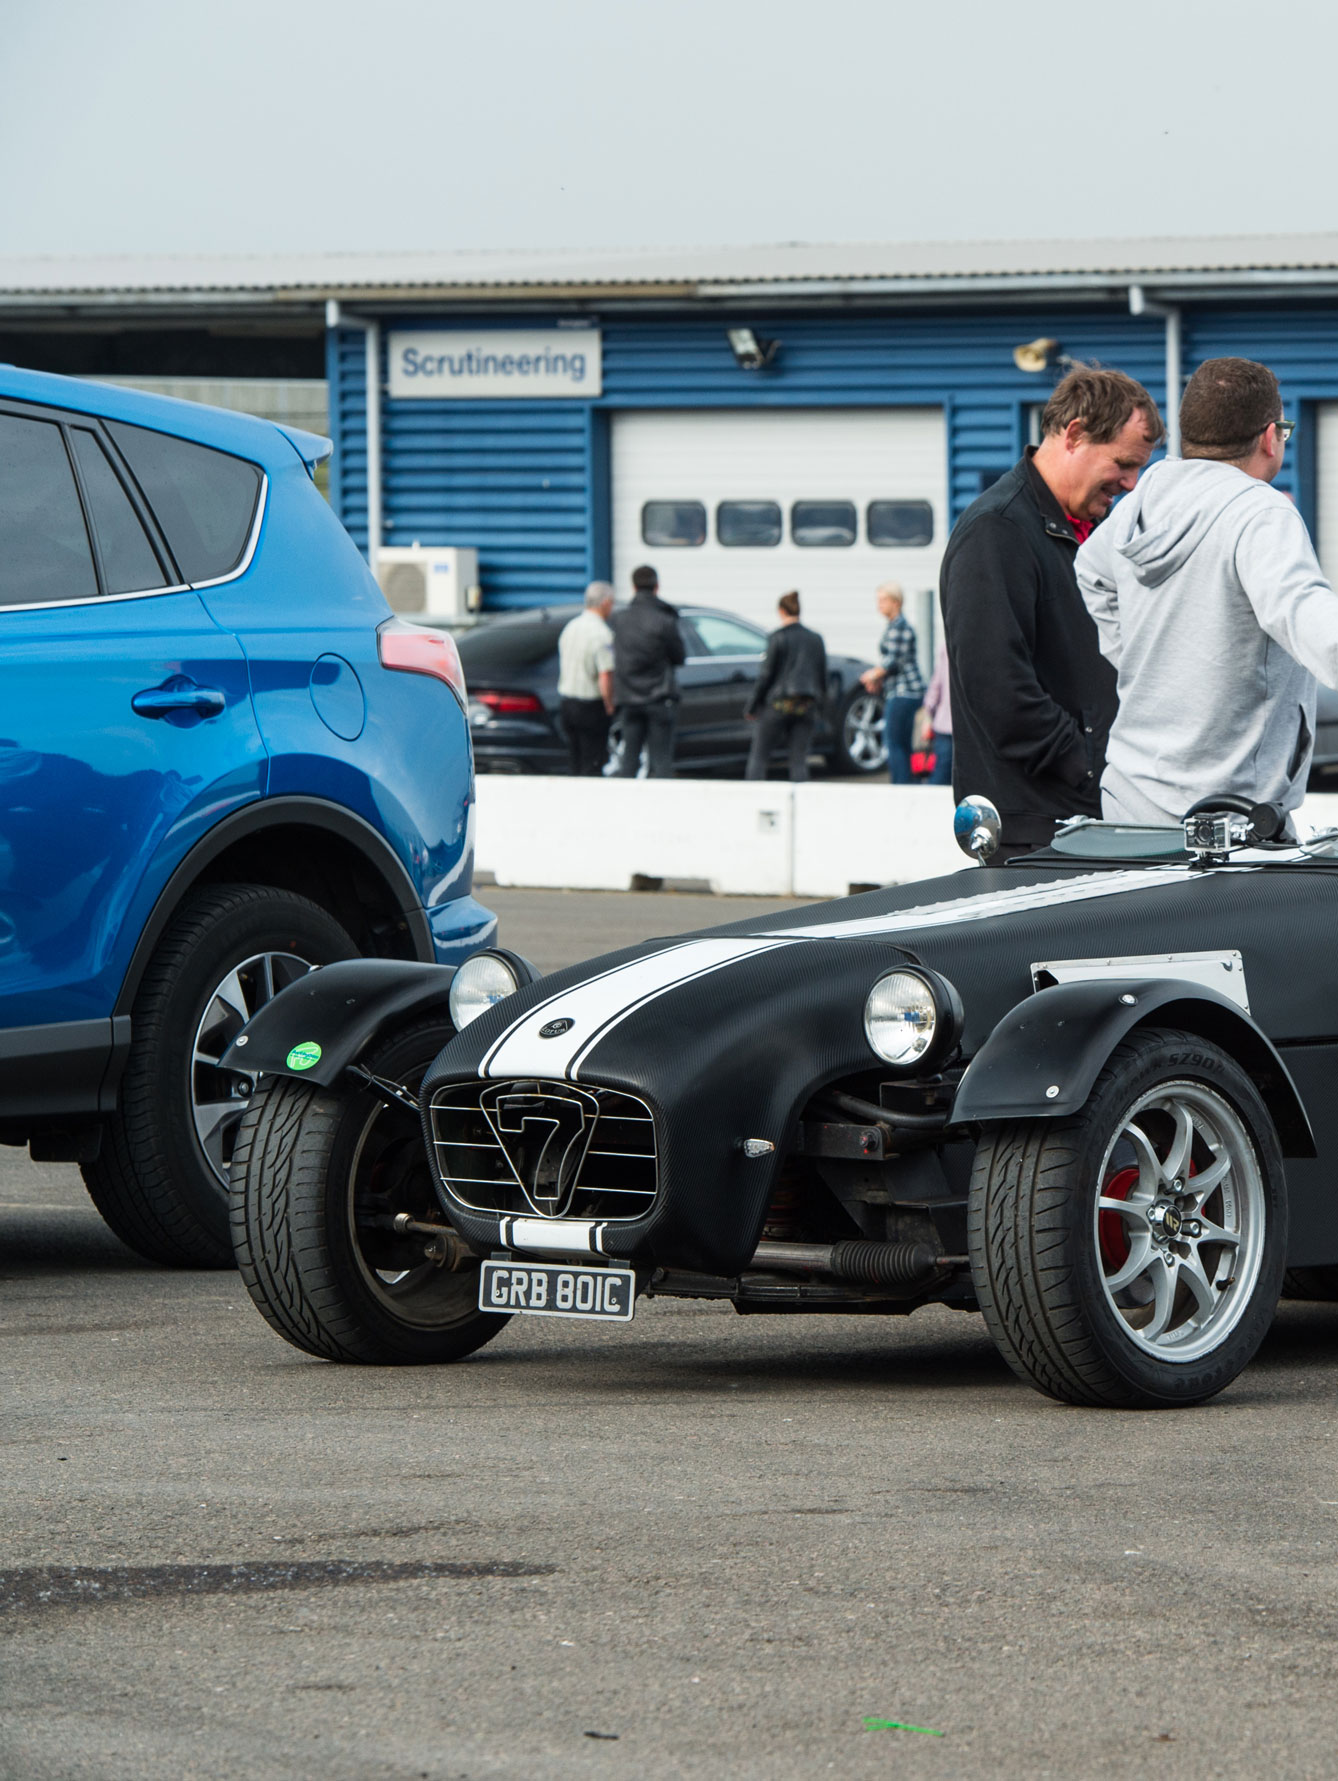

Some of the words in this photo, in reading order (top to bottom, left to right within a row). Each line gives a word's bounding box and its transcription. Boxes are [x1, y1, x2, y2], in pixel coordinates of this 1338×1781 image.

[402, 346, 586, 382] Scrutineering
[491, 1270, 548, 1307] GRB
[556, 1274, 622, 1312] 801C
